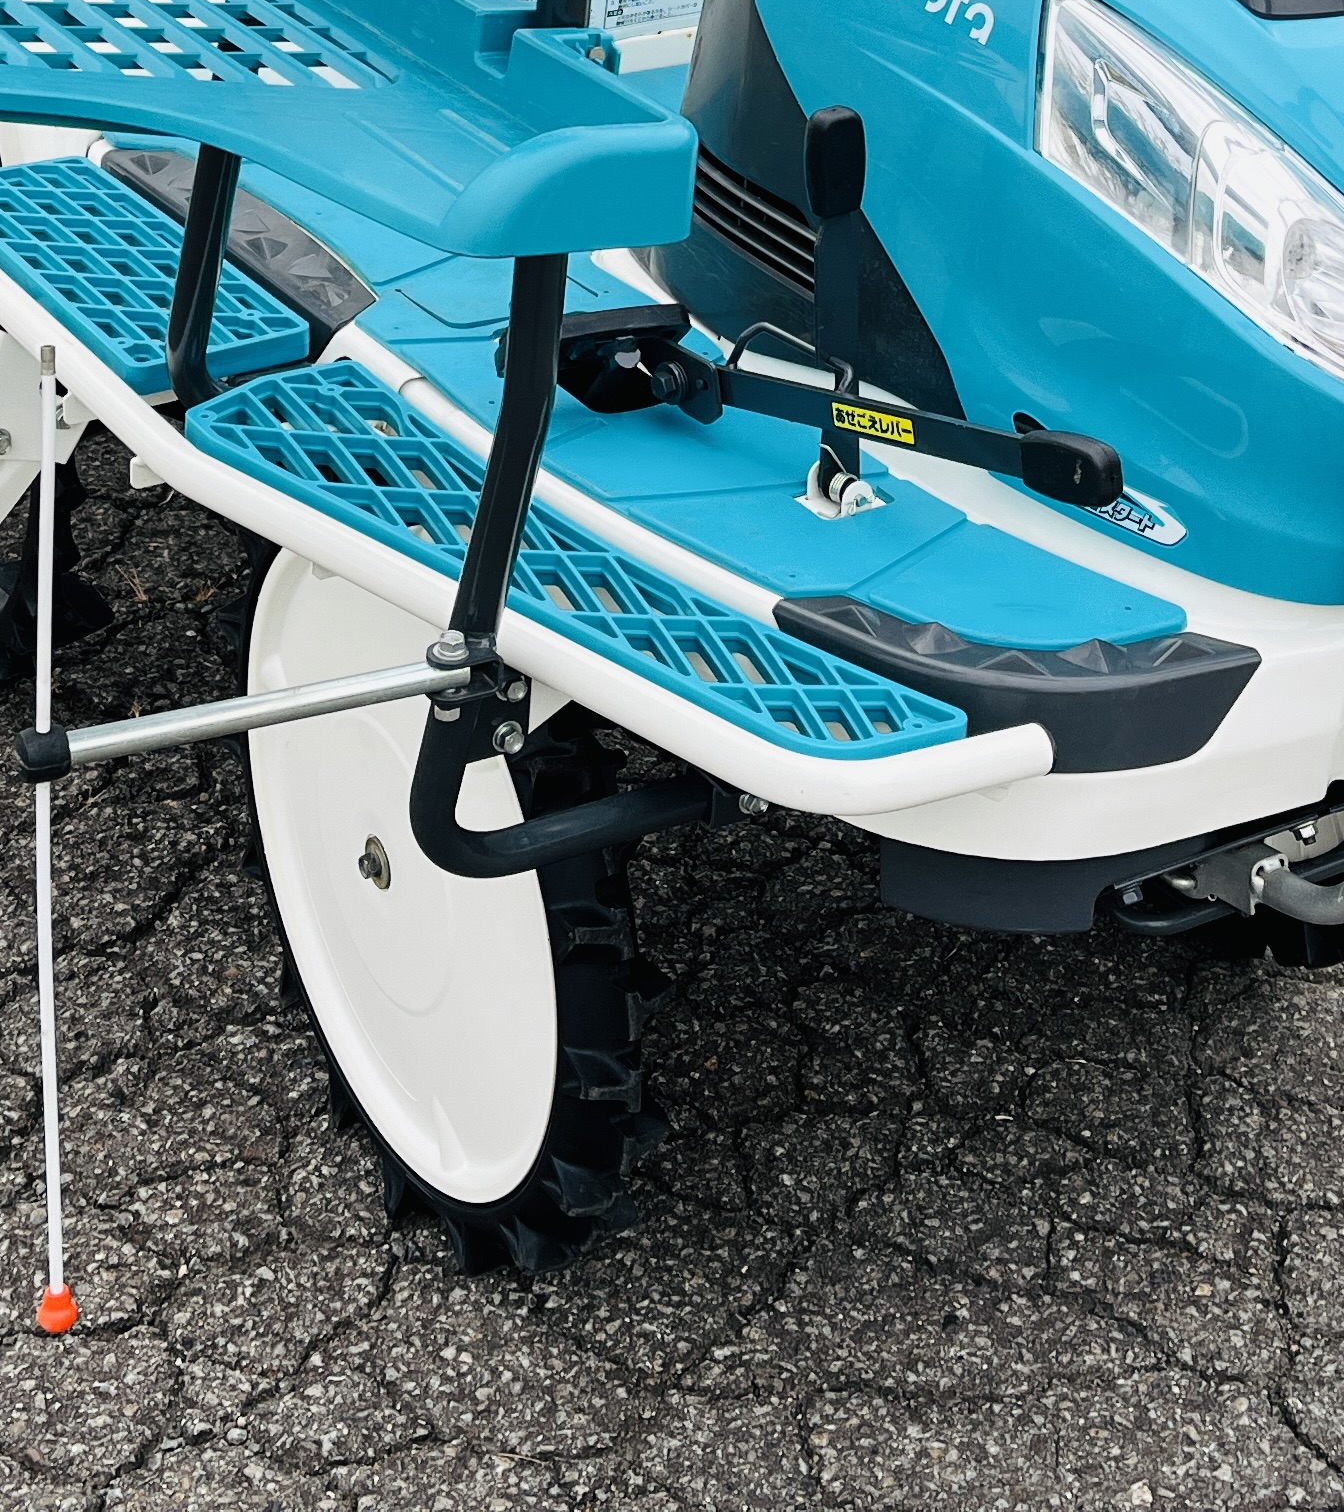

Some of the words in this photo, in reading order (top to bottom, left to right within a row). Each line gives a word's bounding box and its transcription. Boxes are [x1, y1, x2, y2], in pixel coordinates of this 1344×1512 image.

[834, 407, 913, 438] あぜごえレバー
[1097, 501, 1155, 533] スタート
